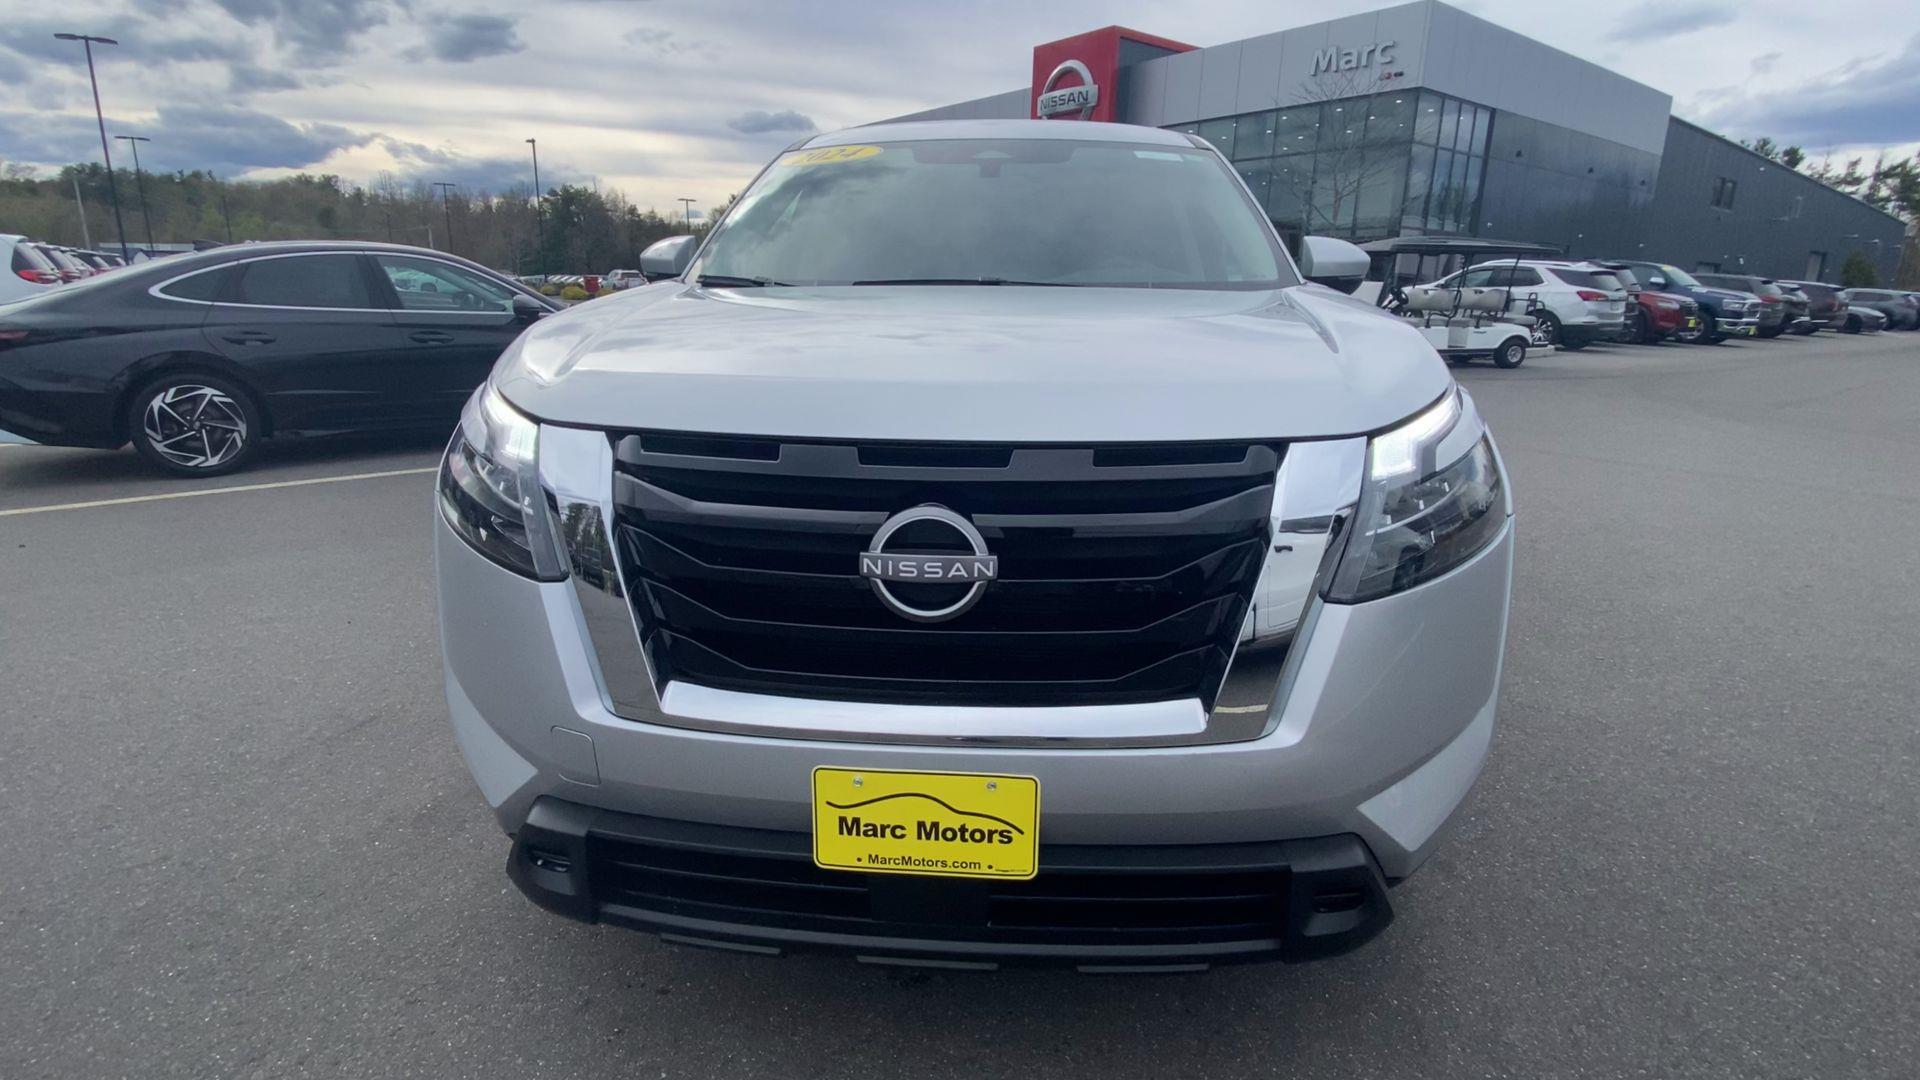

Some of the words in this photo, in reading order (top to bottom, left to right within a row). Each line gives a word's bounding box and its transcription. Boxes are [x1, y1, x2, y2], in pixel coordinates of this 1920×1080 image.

[1310, 40, 1396, 77] Marc
[1040, 90, 1089, 111] NISSAN
[862, 557, 994, 578] NISSAN
[838, 816, 907, 840] Marc
[916, 820, 1014, 845] Motors
[867, 854, 982, 871] MarcMotors.com
